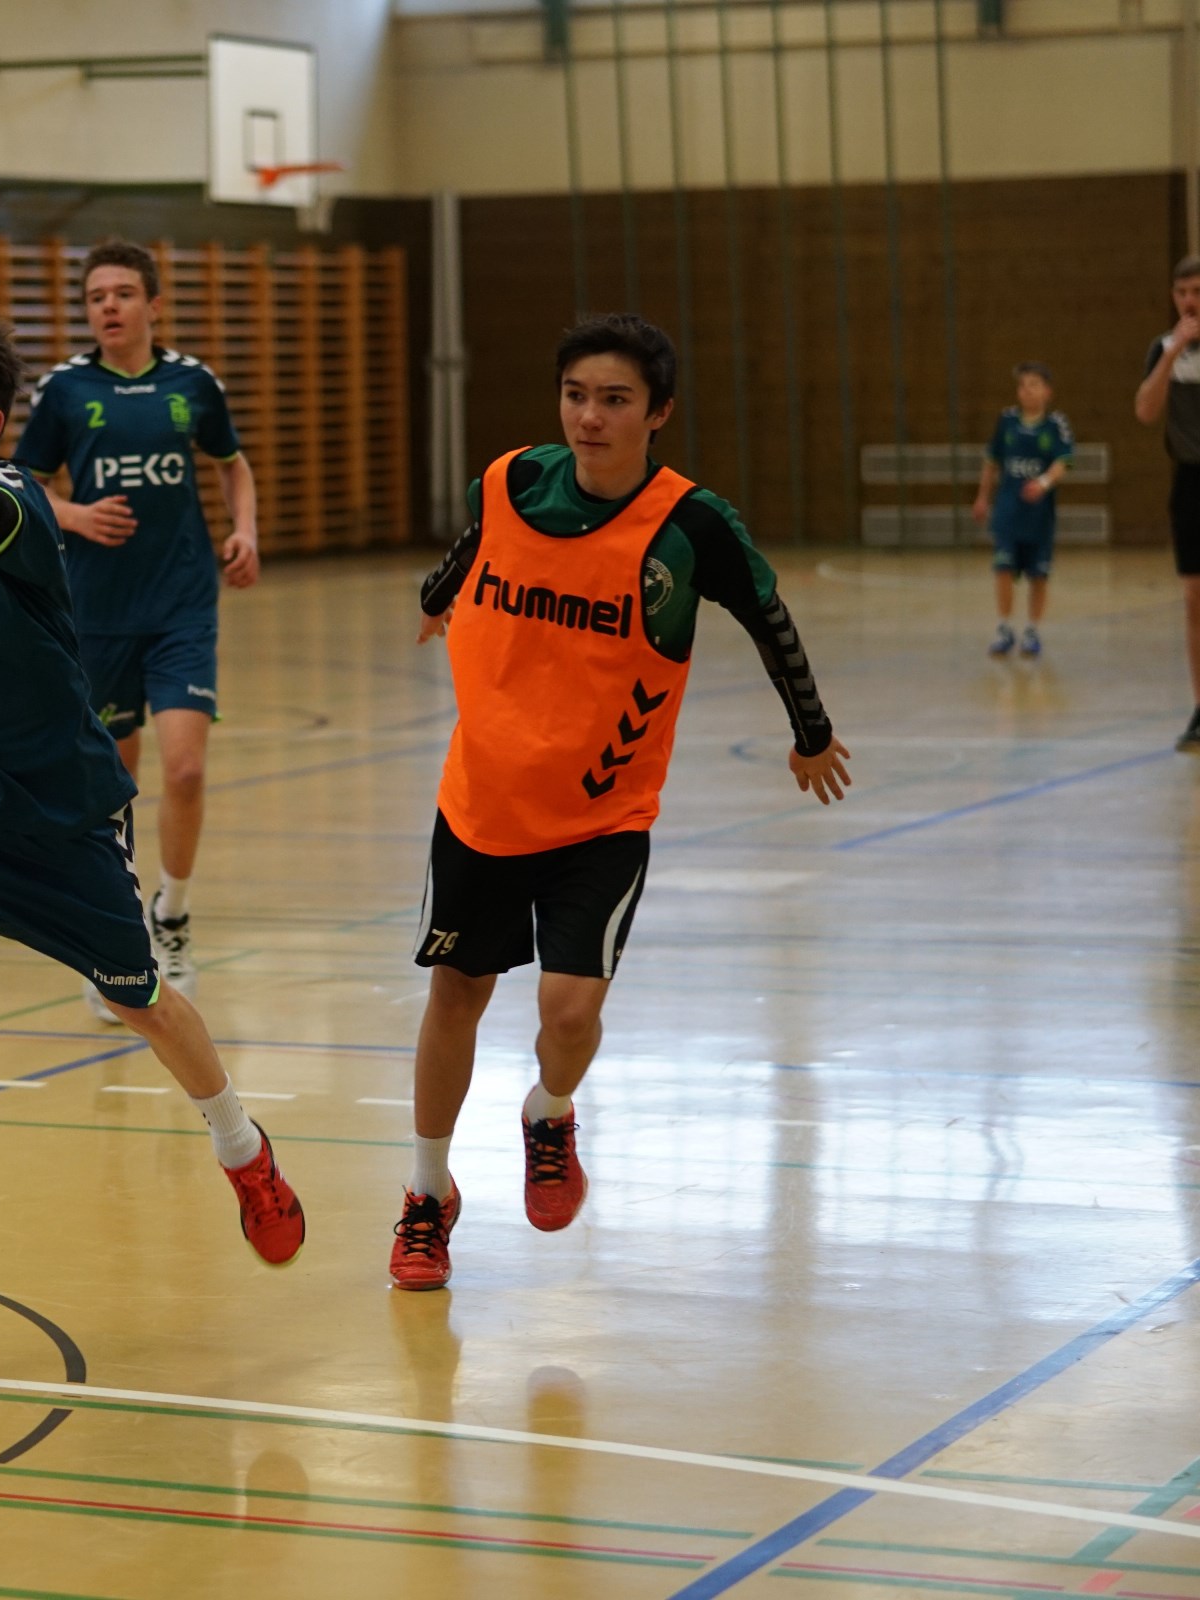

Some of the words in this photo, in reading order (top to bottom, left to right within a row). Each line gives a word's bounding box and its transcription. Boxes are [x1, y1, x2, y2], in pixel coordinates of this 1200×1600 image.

[85, 401, 106, 429] 2
[94, 452, 185, 489] PEKO
[474, 560, 633, 639] hummel
[426, 928, 460, 956] 79
[93, 967, 148, 986] hummel
